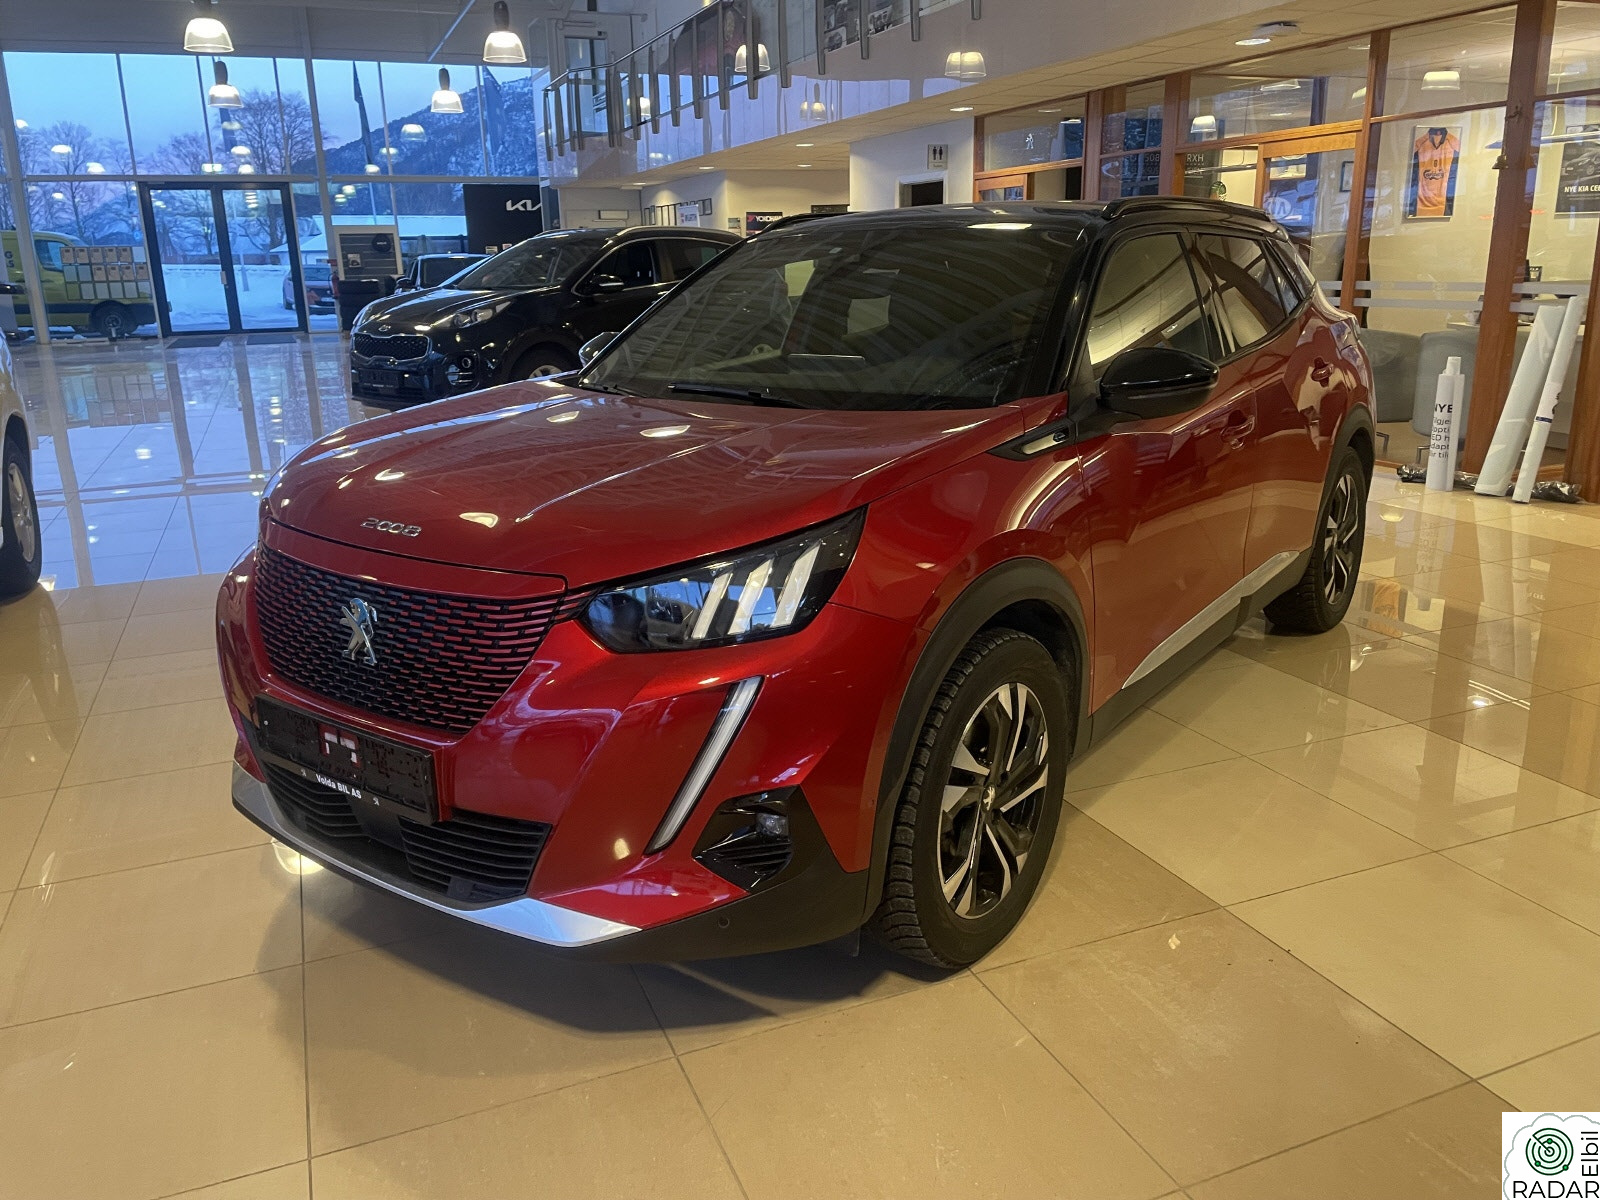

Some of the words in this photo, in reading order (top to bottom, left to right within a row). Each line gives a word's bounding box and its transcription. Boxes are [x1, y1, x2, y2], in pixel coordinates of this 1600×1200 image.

[1564, 185, 1578, 193] NYE
[1578, 185, 1590, 193] KIA
[359, 517, 422, 537] 2008
[315, 773, 337, 789] Volda
[337, 782, 350, 795] BIL
[351, 788, 362, 799] AS
